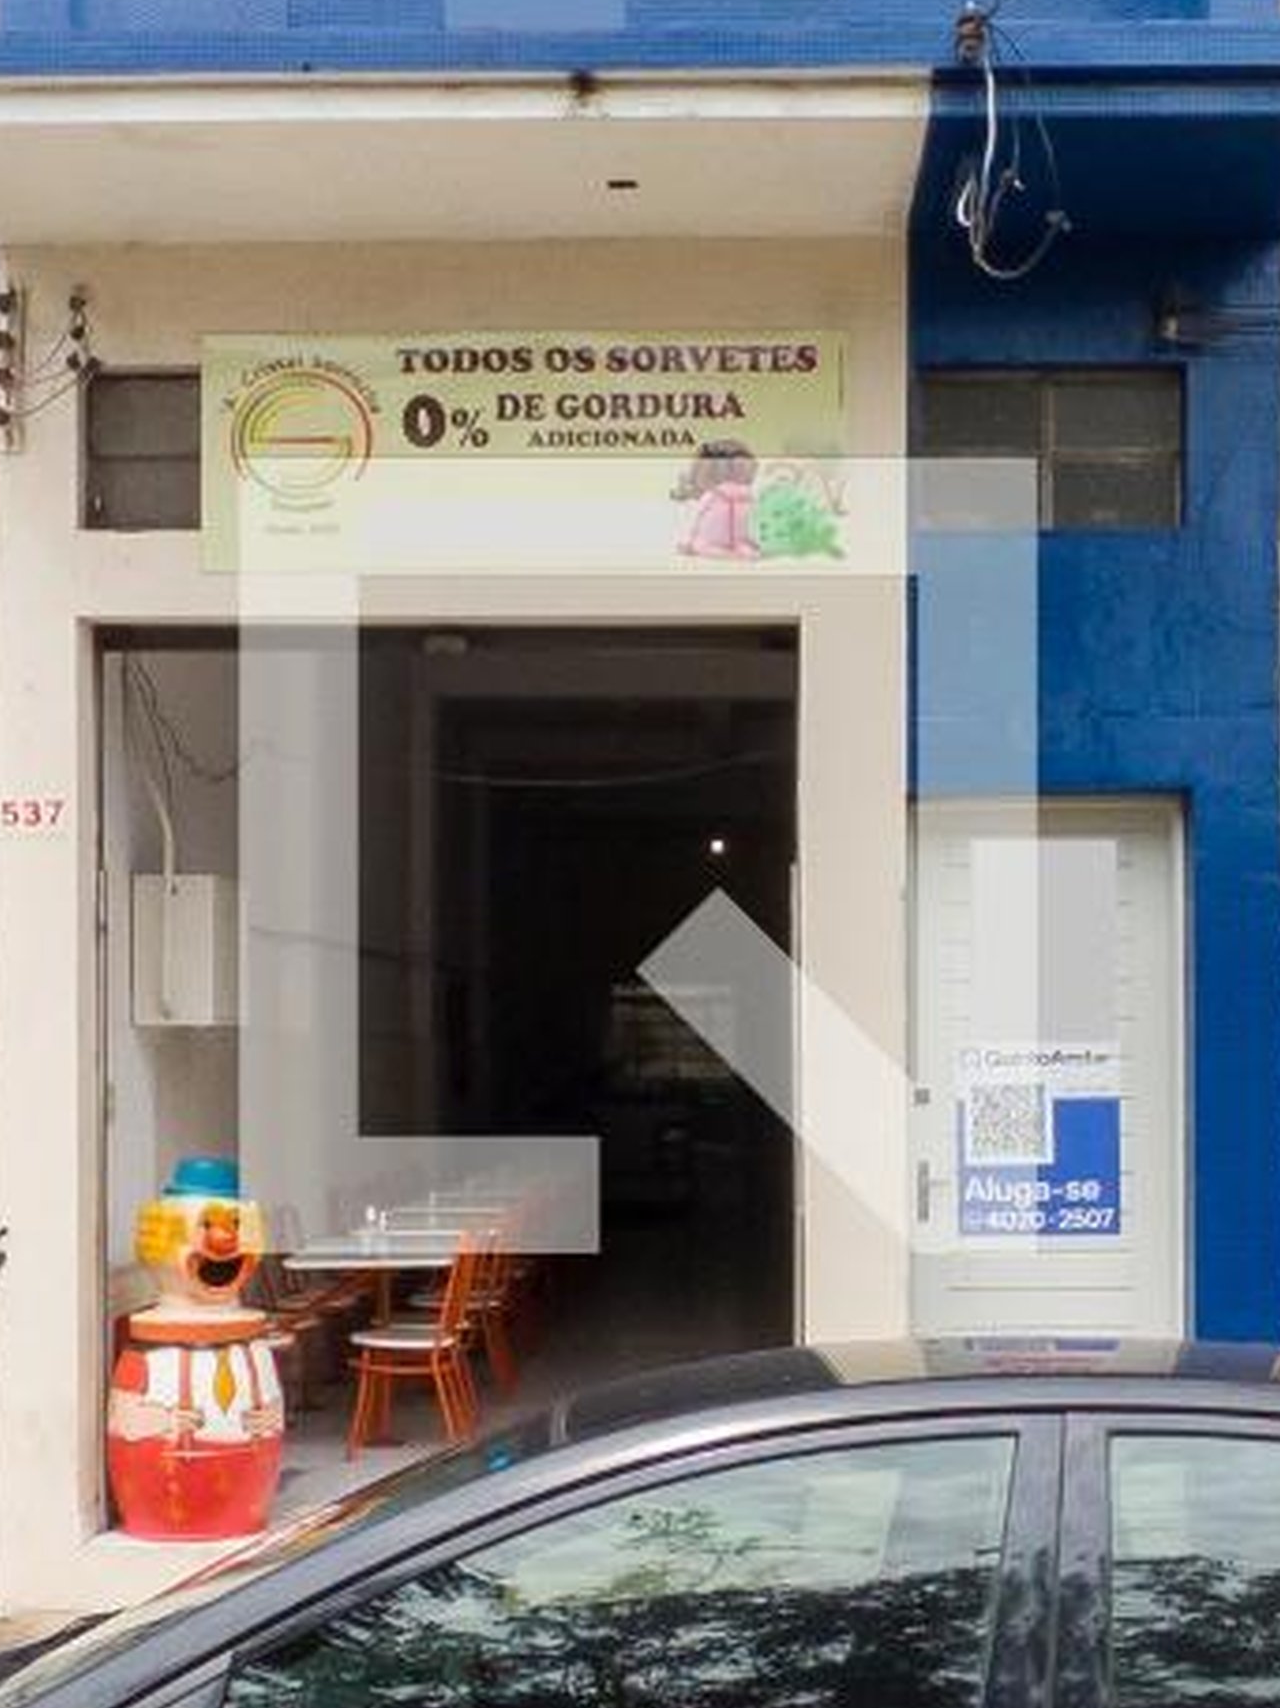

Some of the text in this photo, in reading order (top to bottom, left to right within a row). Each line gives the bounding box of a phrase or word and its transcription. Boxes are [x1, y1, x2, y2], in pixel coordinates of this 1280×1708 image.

[397, 345, 818, 374] TODOS OS SORVETES
[403, 394, 490, 448] 0%
[495, 392, 746, 421] DE GORDURA
[527, 429, 696, 448] ADICIONADA
[1, 800, 64, 827] 537
[964, 1176, 1102, 1208] Aluga-se
